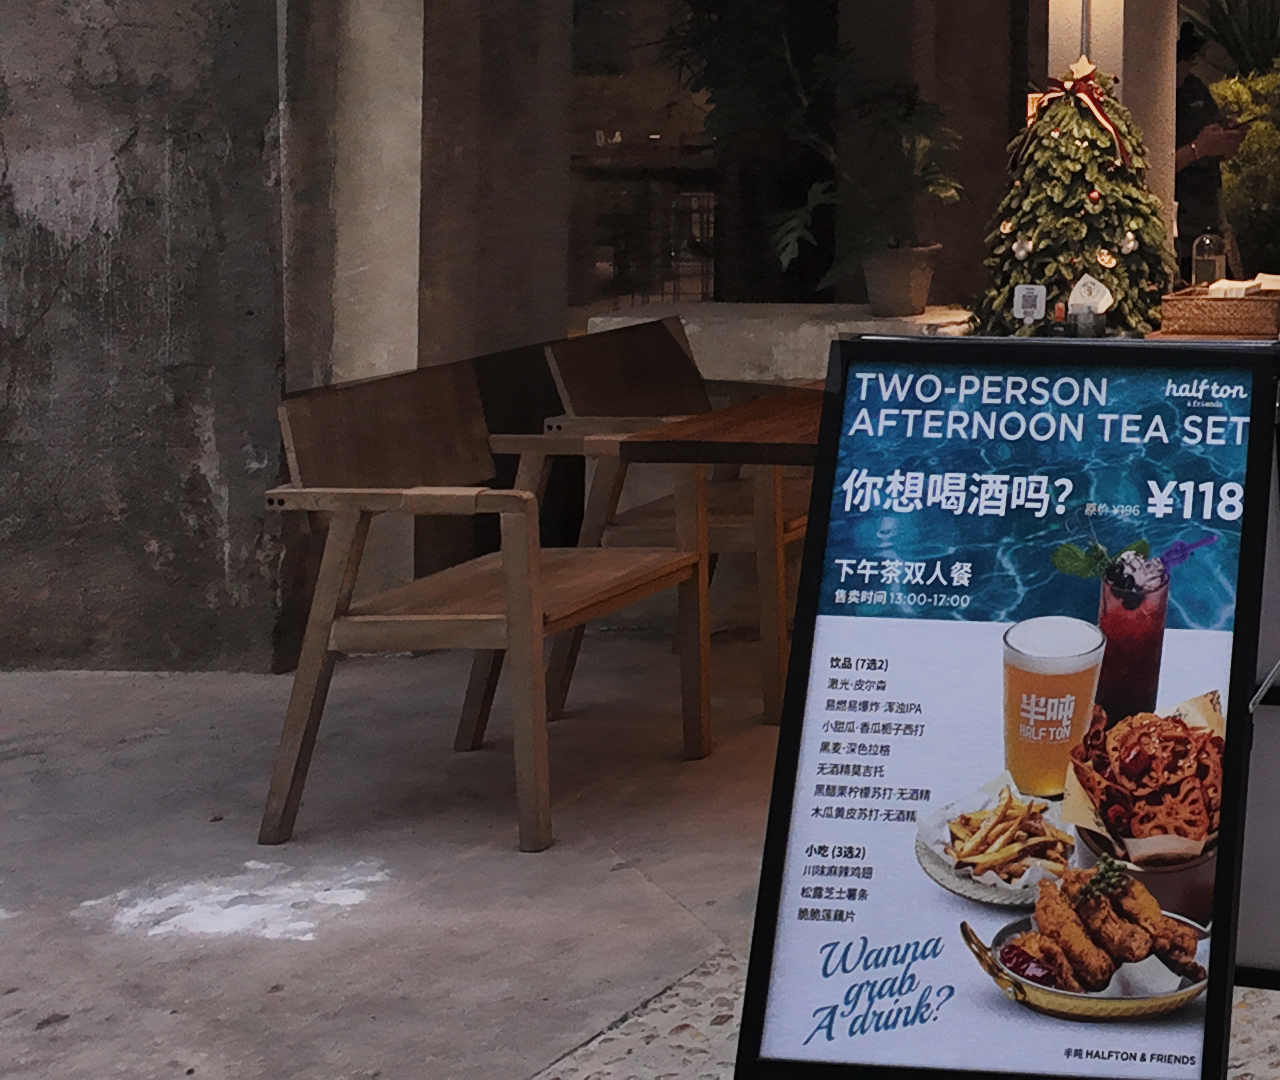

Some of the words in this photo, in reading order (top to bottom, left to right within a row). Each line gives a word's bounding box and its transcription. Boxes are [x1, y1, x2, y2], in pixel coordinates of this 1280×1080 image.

[855, 373, 1107, 406] TWO-PERSON
[848, 408, 1084, 442] AFTERNOON
[1098, 413, 1169, 444] TEA
[1182, 415, 1250, 445] SET
[1147, 480, 1244, 521] ¥118
[834, 559, 972, 587] 下午茶双人餐
[835, 589, 887, 604] 售卖时间
[890, 591, 970, 607] 13:00-17:00
[830, 657, 852, 669] 饮品
[1020, 693, 1076, 726] 半吨
[816, 763, 884, 777] 无酒精莫吉托
[805, 844, 829, 857] 小吃
[800, 886, 868, 901] 松露芝士薯条
[819, 936, 945, 978] Wanna
[840, 961, 920, 1018] grab
[802, 1004, 839, 1045] A
[848, 985, 955, 1037] drink?
[1085, 1049, 1137, 1061] HALFTON
[1140, 1052, 1146, 1062] &
[1149, 1053, 1196, 1066] FRIENDS
